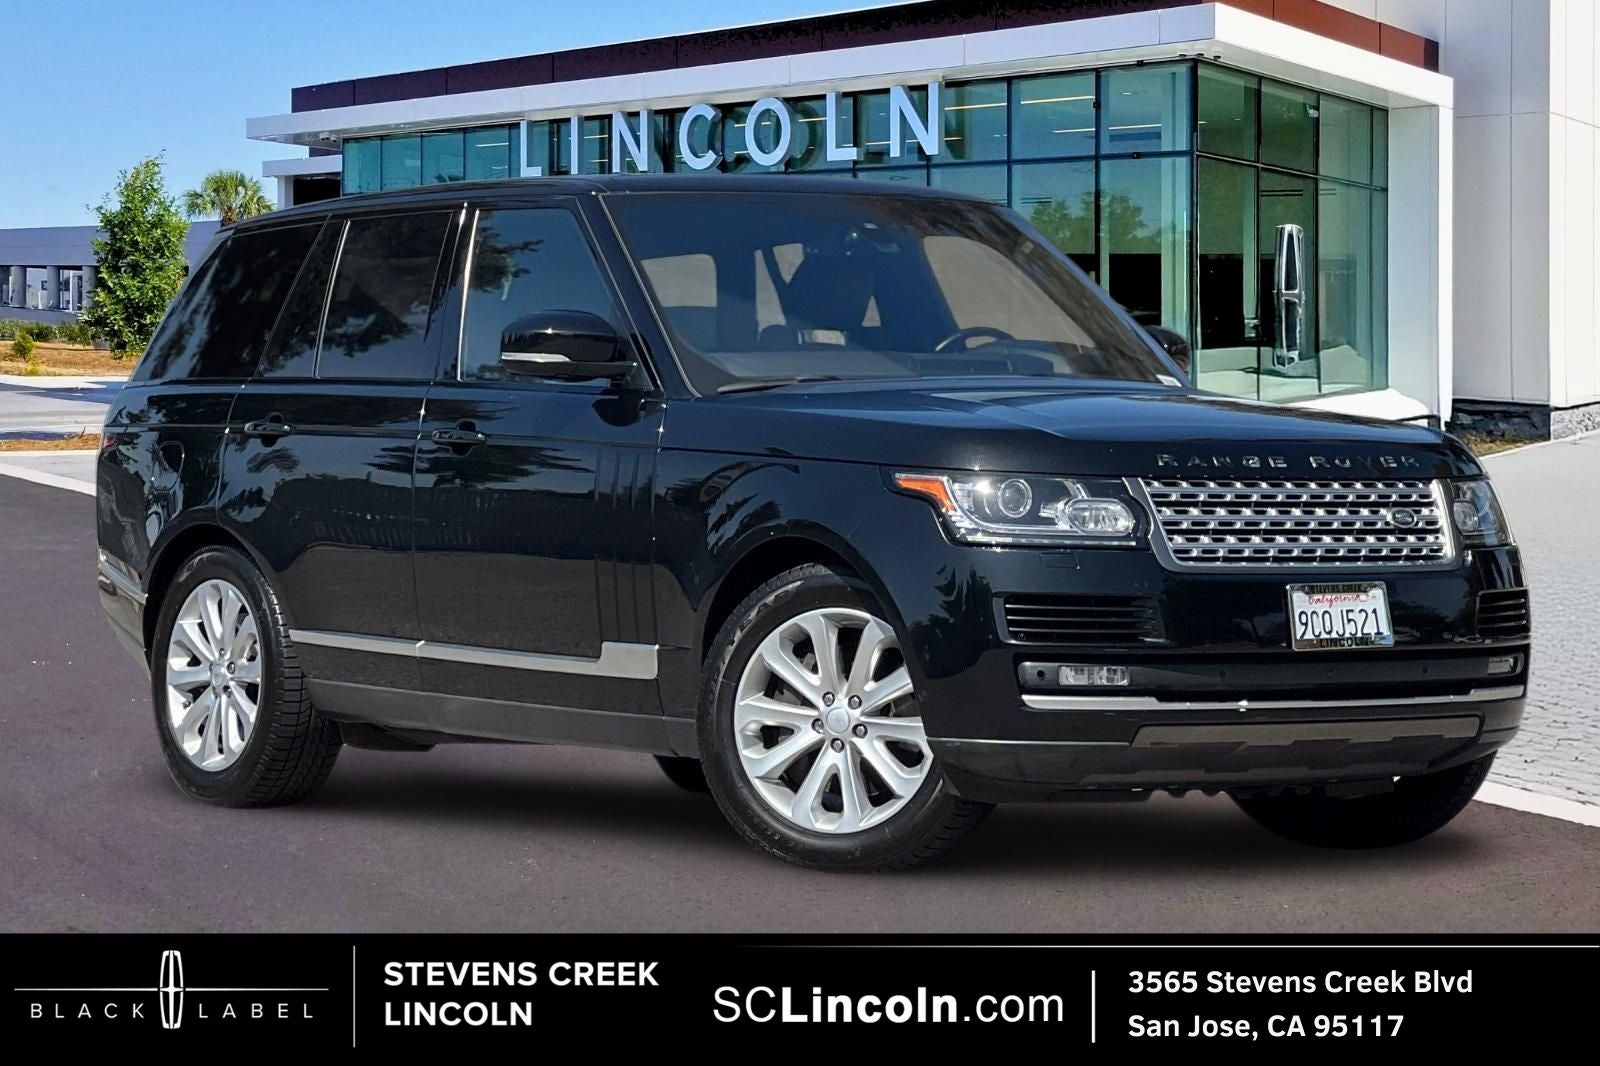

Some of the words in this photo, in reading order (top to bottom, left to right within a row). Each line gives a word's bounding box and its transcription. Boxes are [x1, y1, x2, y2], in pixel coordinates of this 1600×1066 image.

[520, 81, 940, 176] LINCOLN
[1157, 454, 1287, 467] RANGE
[1310, 456, 1419, 468] ROVER
[1298, 607, 1384, 640] 9CQJ521
